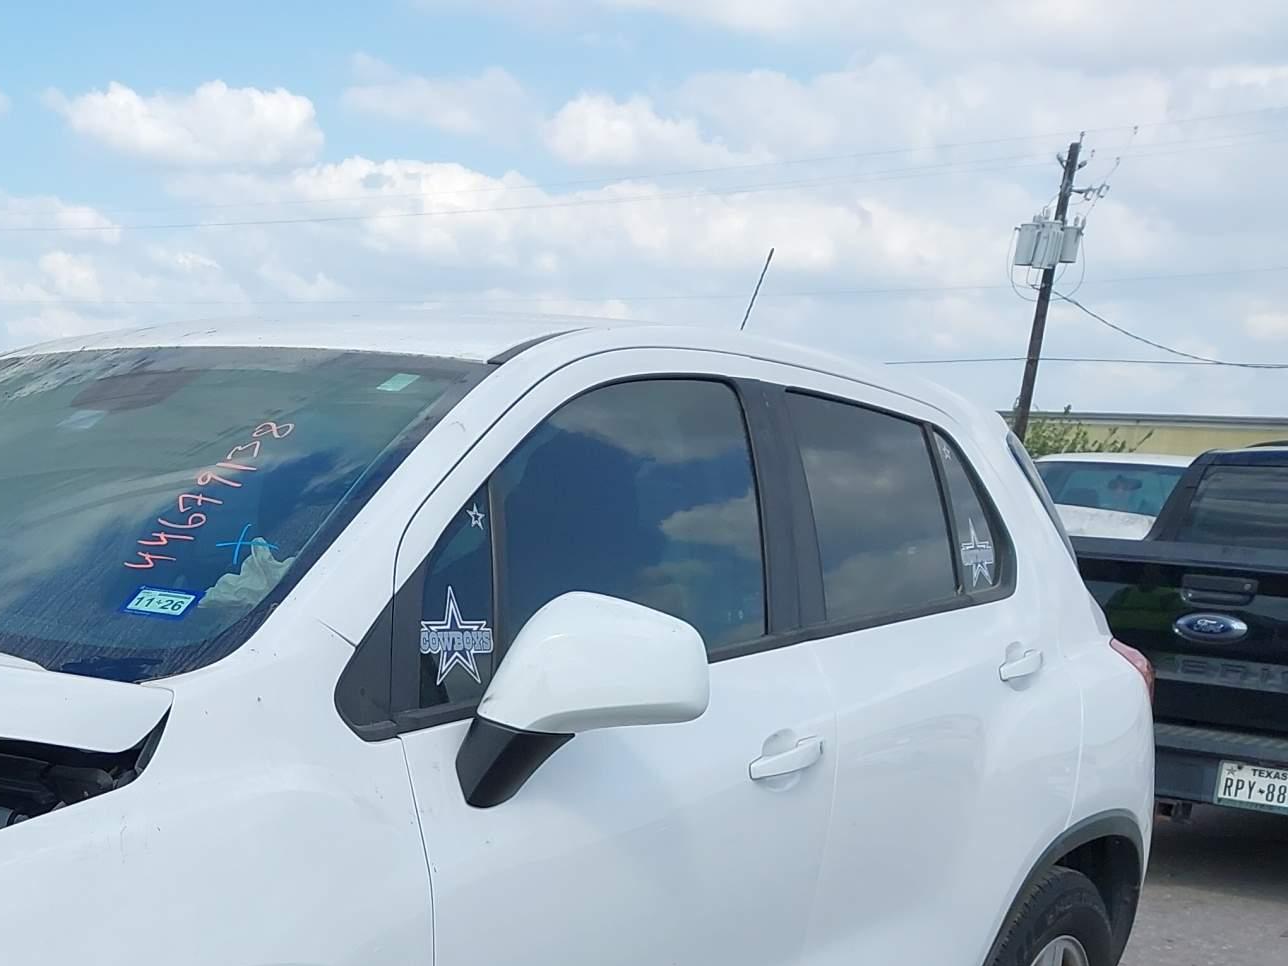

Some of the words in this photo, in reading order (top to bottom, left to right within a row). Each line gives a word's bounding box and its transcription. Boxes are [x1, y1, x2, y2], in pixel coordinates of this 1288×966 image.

[123, 422, 295, 569] 44679138
[1192, 619, 1226, 633] Ford
[420, 630, 491, 651] COWBOYS
[1251, 768, 1288, 781] TEXAS
